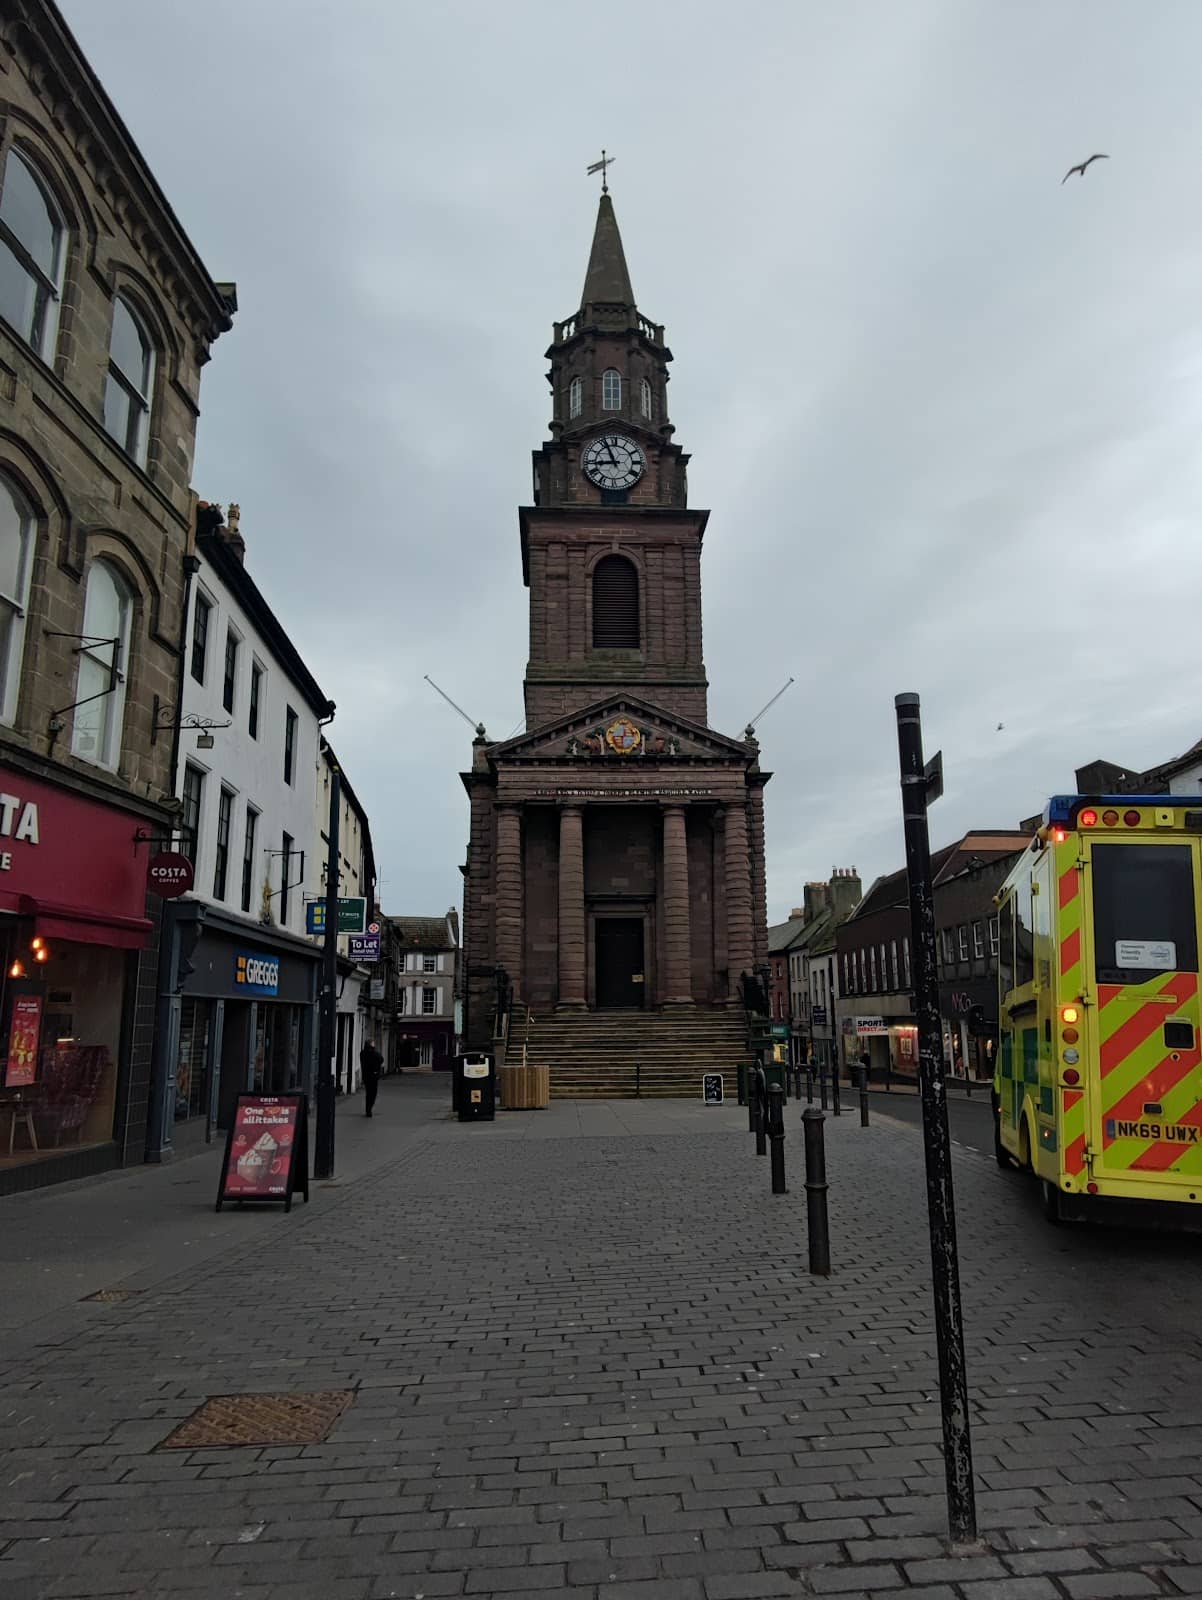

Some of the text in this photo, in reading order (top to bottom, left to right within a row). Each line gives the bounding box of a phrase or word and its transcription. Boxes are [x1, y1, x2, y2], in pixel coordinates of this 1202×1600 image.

[152, 868, 187, 878] COSTA
[352, 939, 377, 948] To Let
[246, 958, 278, 986] GREGGS
[245, 1107, 264, 1115] One
[263, 1116, 288, 1124] takes
[1118, 1122, 1198, 1142] NK69 UWX
